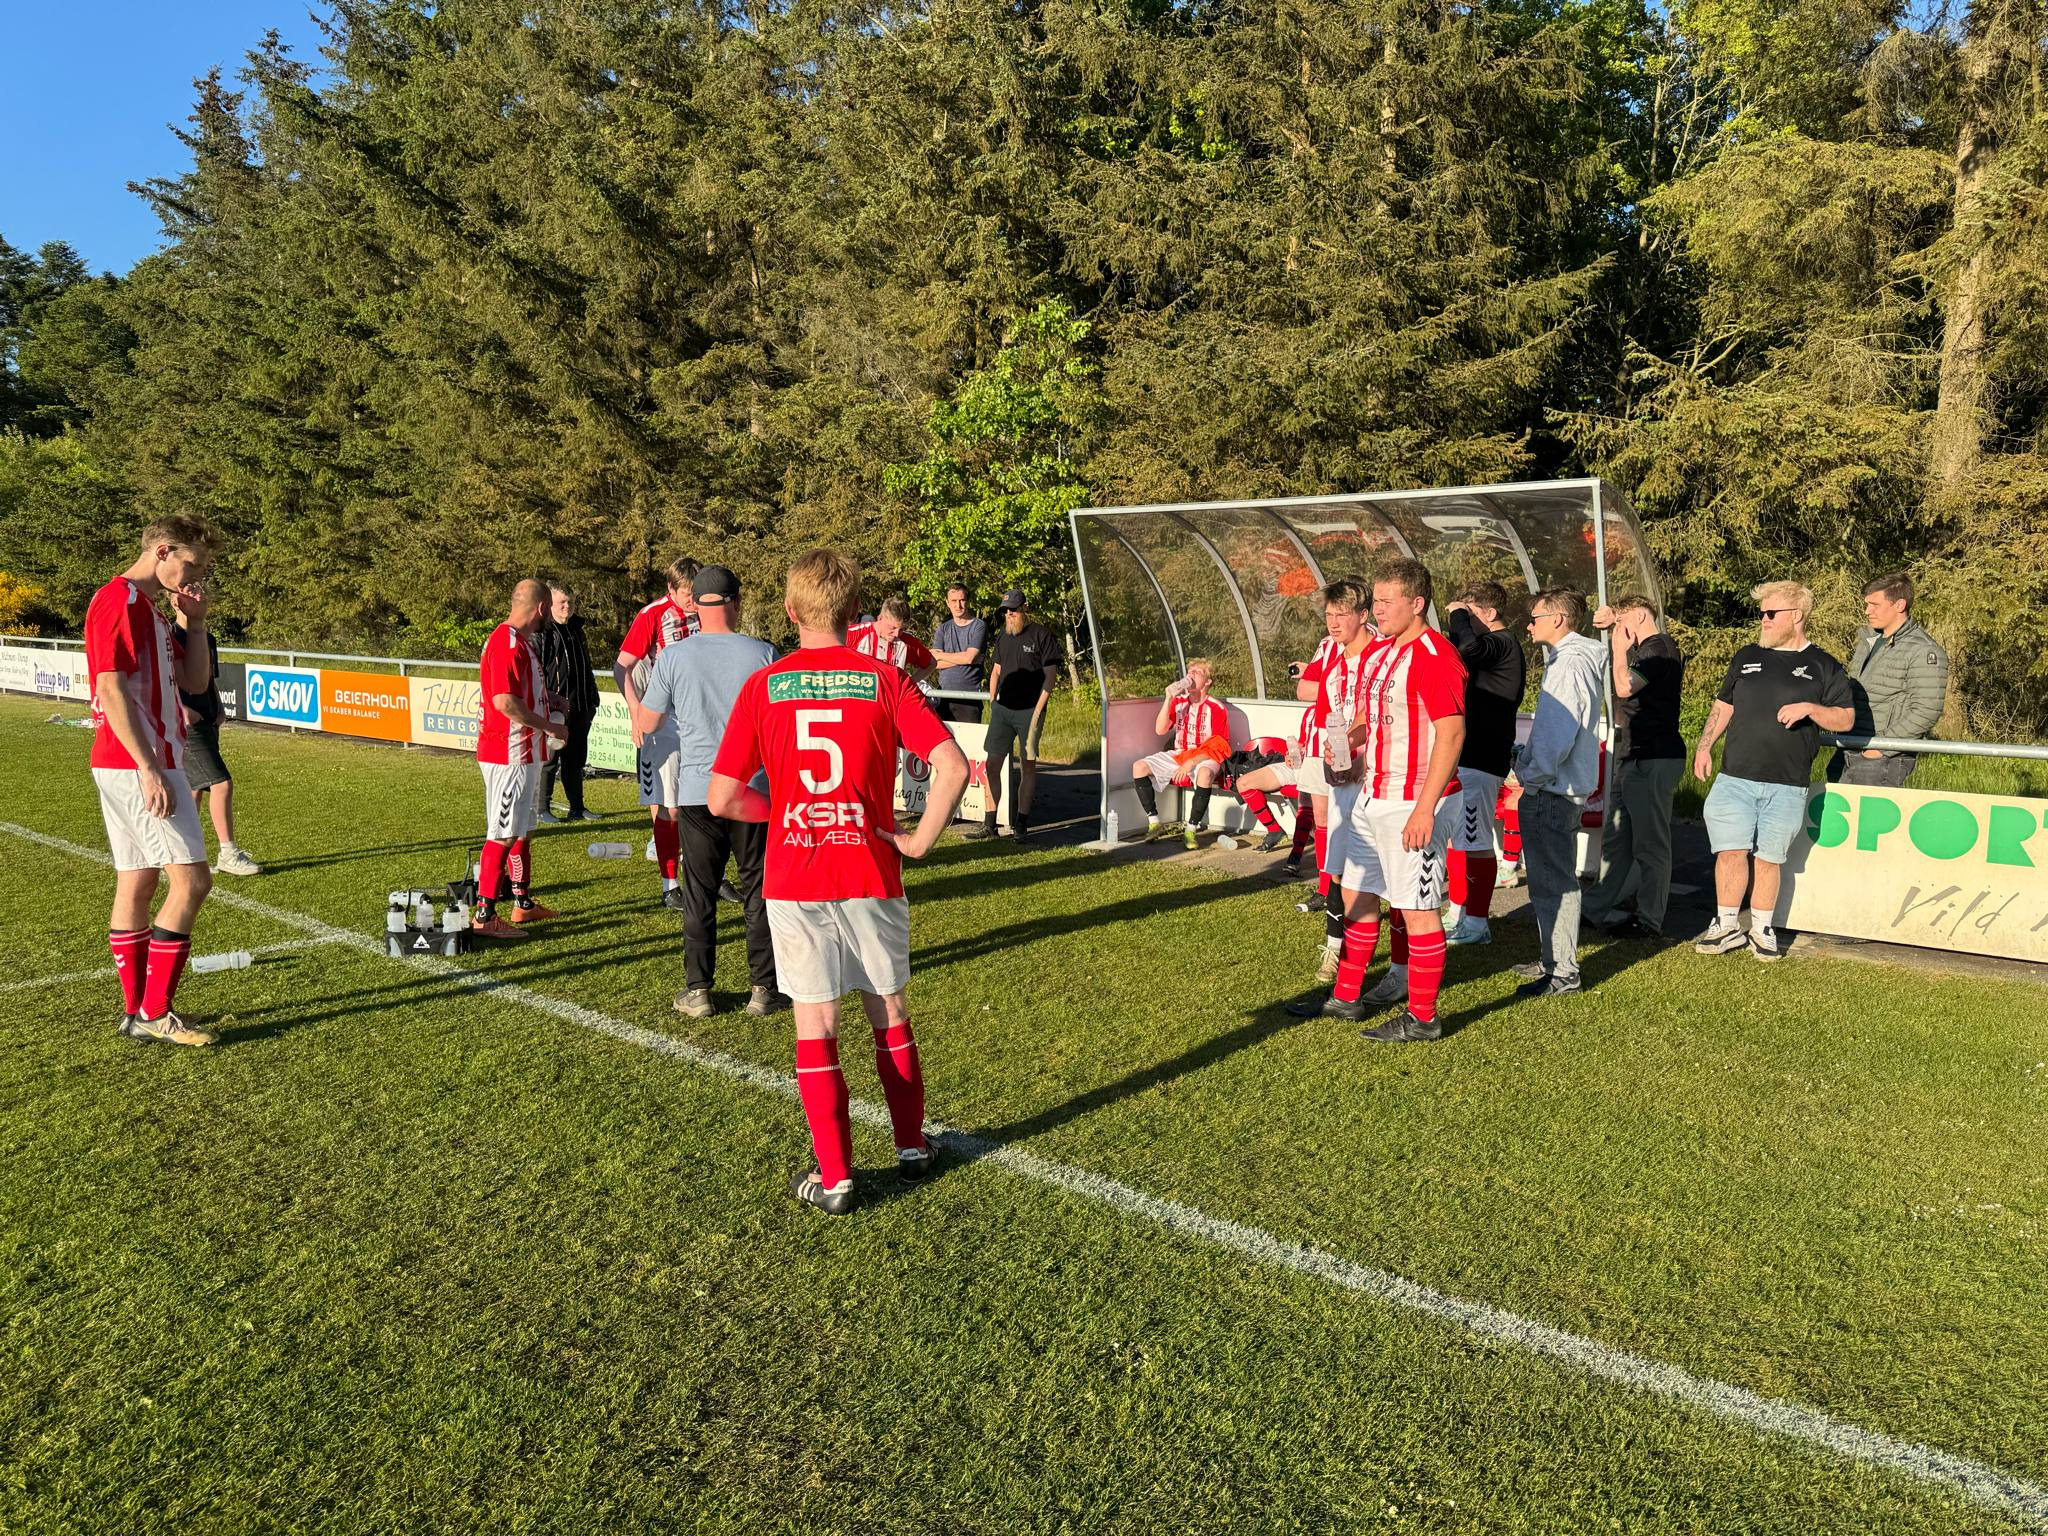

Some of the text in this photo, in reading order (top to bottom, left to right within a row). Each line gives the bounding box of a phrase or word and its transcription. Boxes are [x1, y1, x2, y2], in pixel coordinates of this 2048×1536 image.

[57, 672, 70, 692] Byg
[800, 674, 874, 688] FREDSØ
[267, 680, 315, 714] SKOV
[335, 689, 409, 711] BEIERHOLM
[322, 705, 381, 720] VI SKABER BALANCE
[795, 708, 844, 795] 5
[783, 801, 865, 829] KSR
[1806, 790, 2048, 869] SPOR
[1890, 884, 2020, 941] Vild
